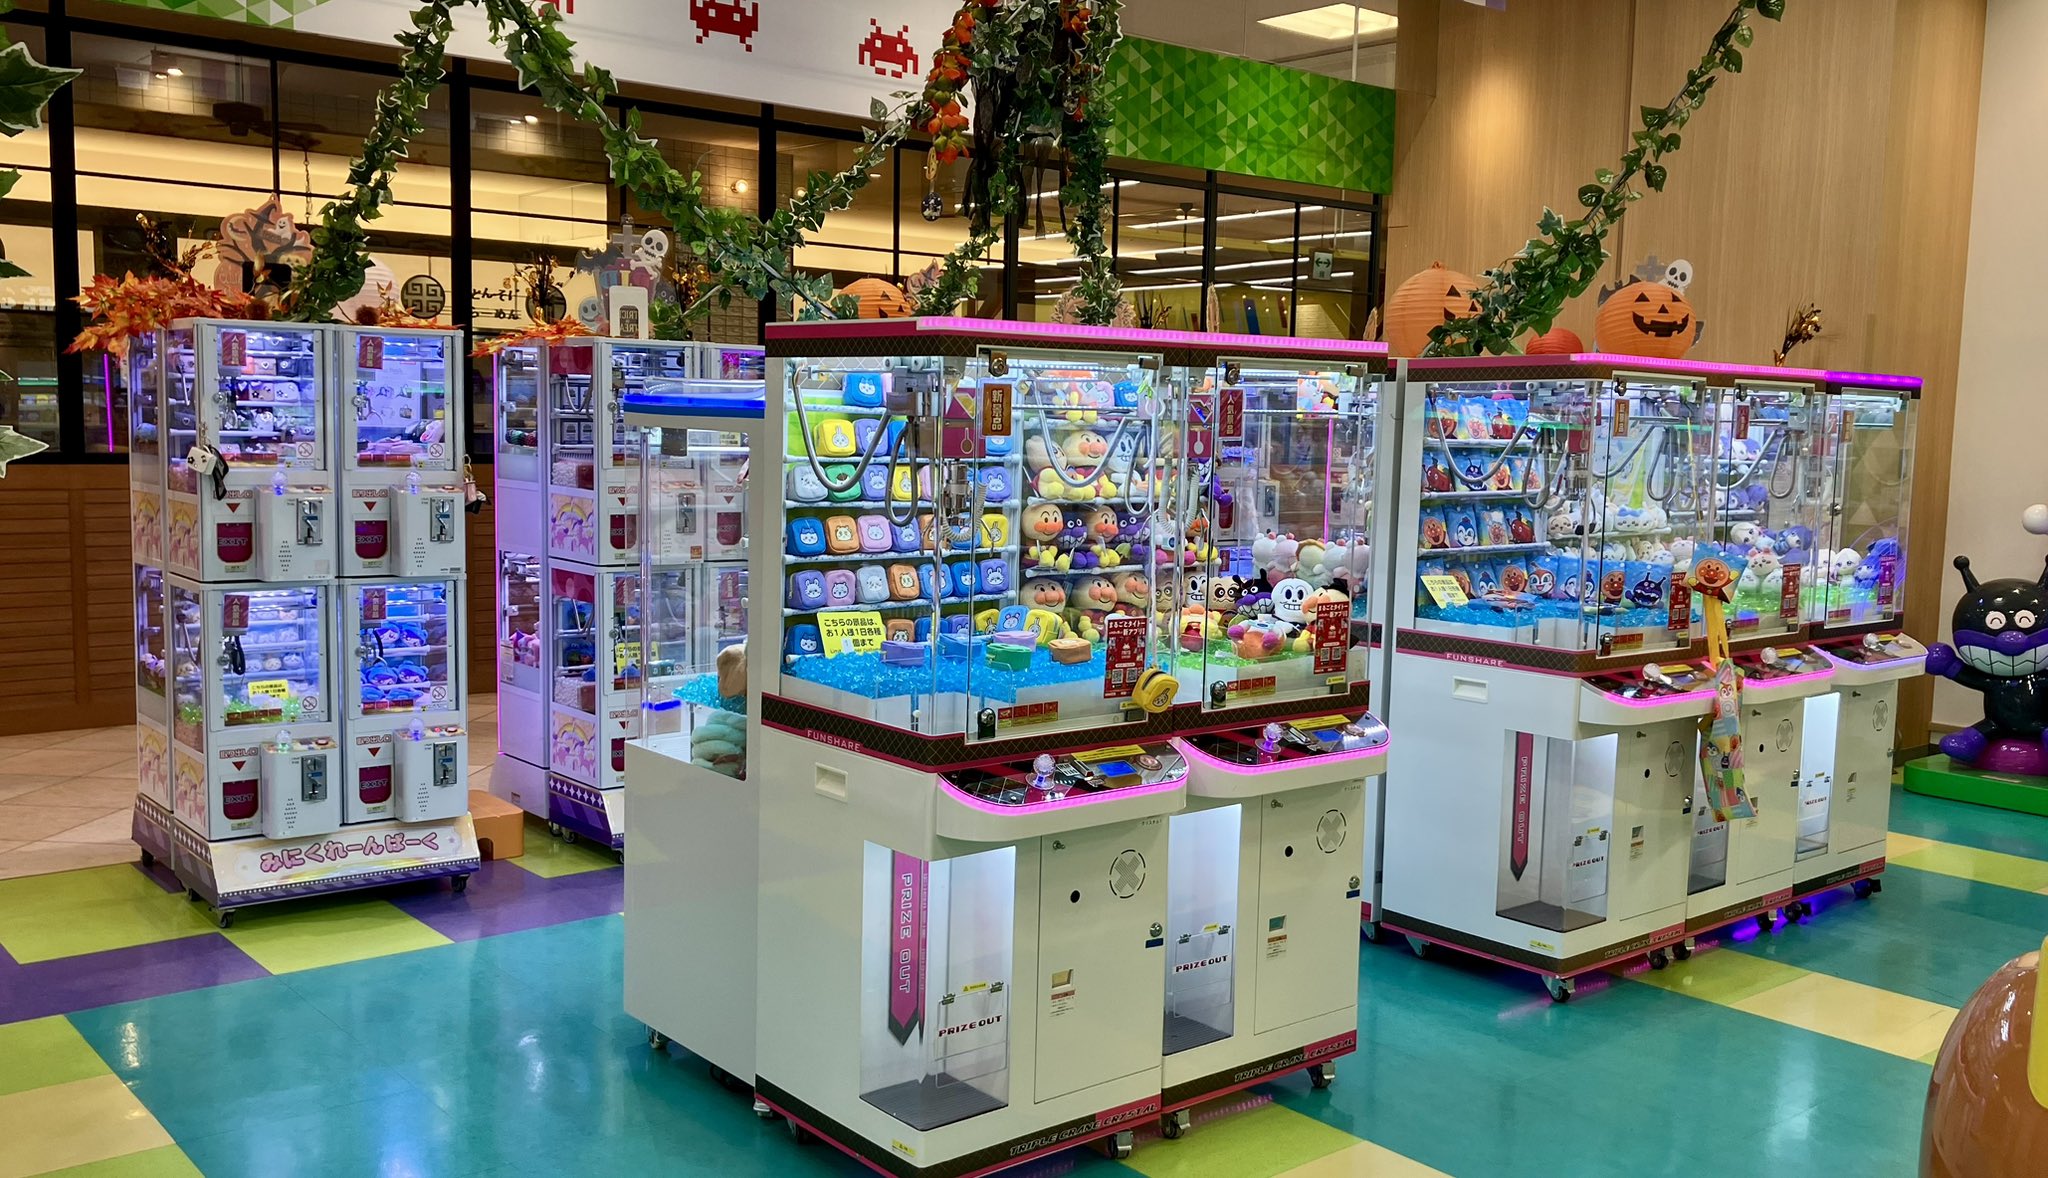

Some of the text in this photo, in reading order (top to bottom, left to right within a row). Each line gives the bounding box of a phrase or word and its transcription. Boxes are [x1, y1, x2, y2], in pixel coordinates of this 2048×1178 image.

[991, 389, 1003, 431] 新景品
[218, 536, 248, 547] EXIT
[355, 535, 385, 545] EXIT
[1109, 621, 1146, 629] まるごとタイトー
[1446, 653, 1504, 667] FUNSHARE
[807, 729, 861, 752] FUNSHARE
[360, 778, 388, 790] EXIT
[223, 793, 255, 805] EXIT
[900, 872, 913, 993] PRIZE OUT
[1175, 955, 1228, 973] PRIZE OUT
[938, 1015, 1003, 1038] PRIZE OUT
[1009, 1102, 1157, 1156] TRIPLE CRANE CRYSTAL
